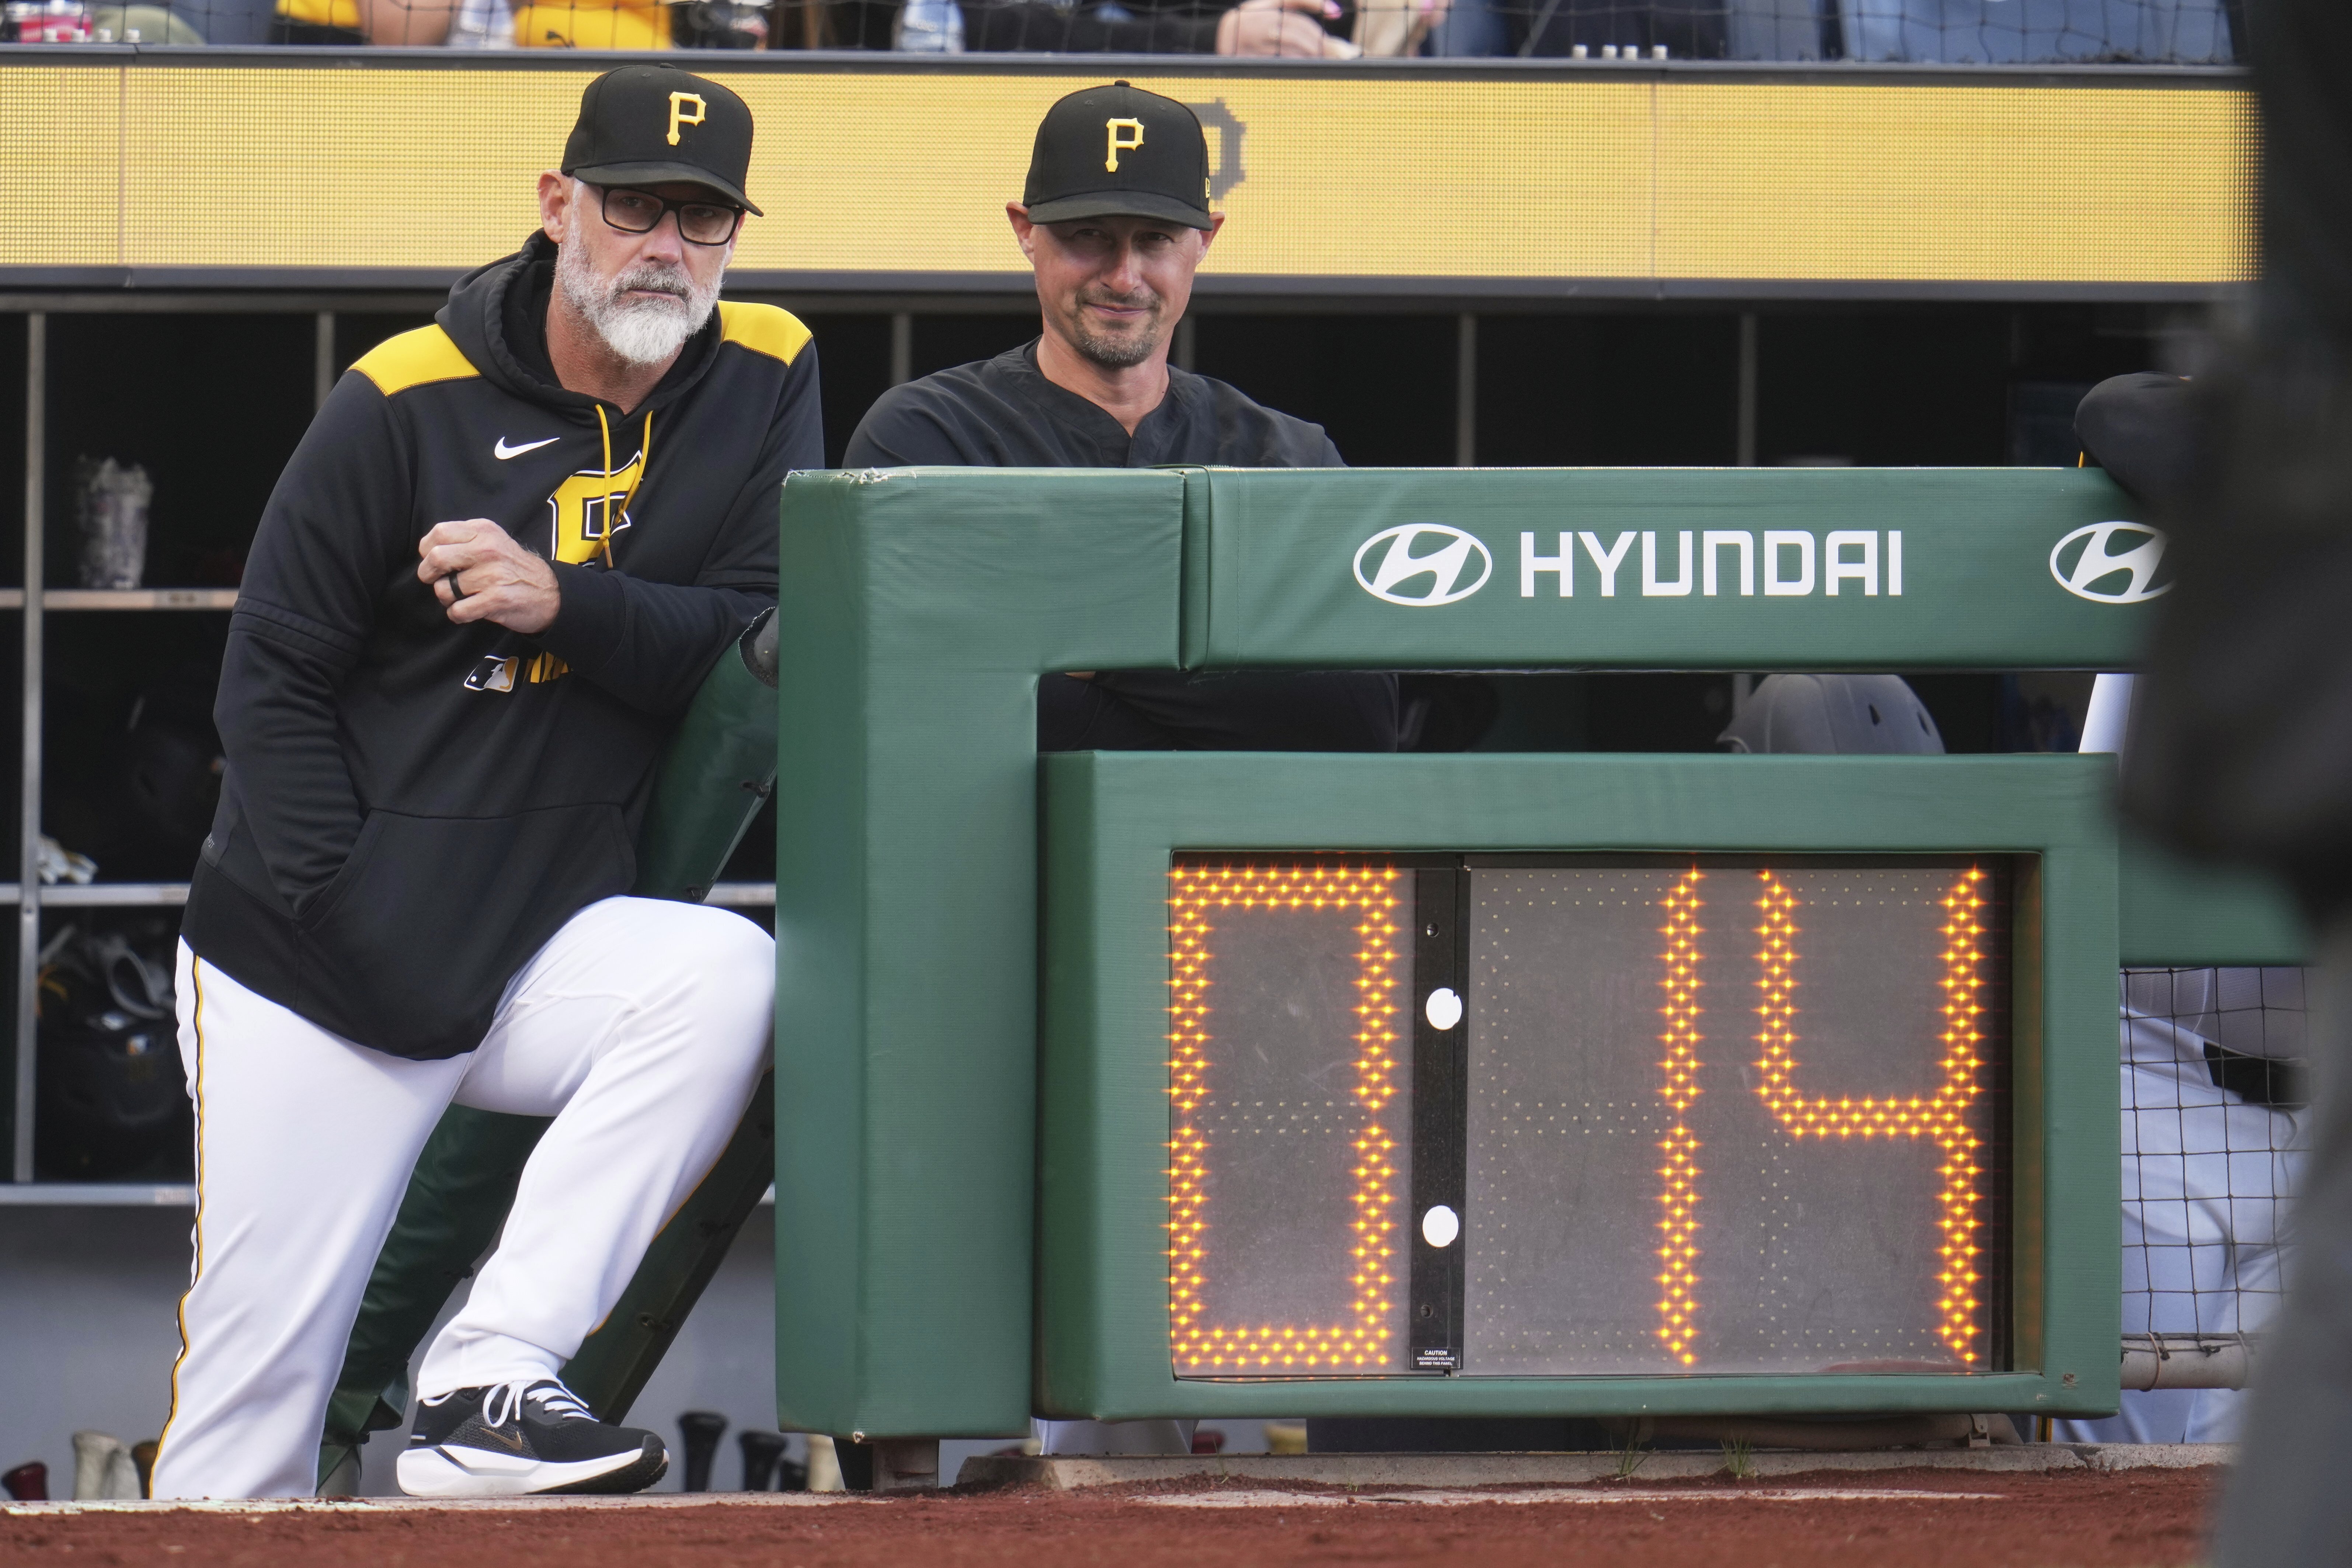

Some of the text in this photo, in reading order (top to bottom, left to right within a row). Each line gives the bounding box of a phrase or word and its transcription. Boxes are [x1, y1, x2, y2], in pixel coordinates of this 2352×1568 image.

[667, 91, 706, 145] P
[1105, 118, 1144, 172] P
[1521, 531, 1902, 597] HYUNDAI
